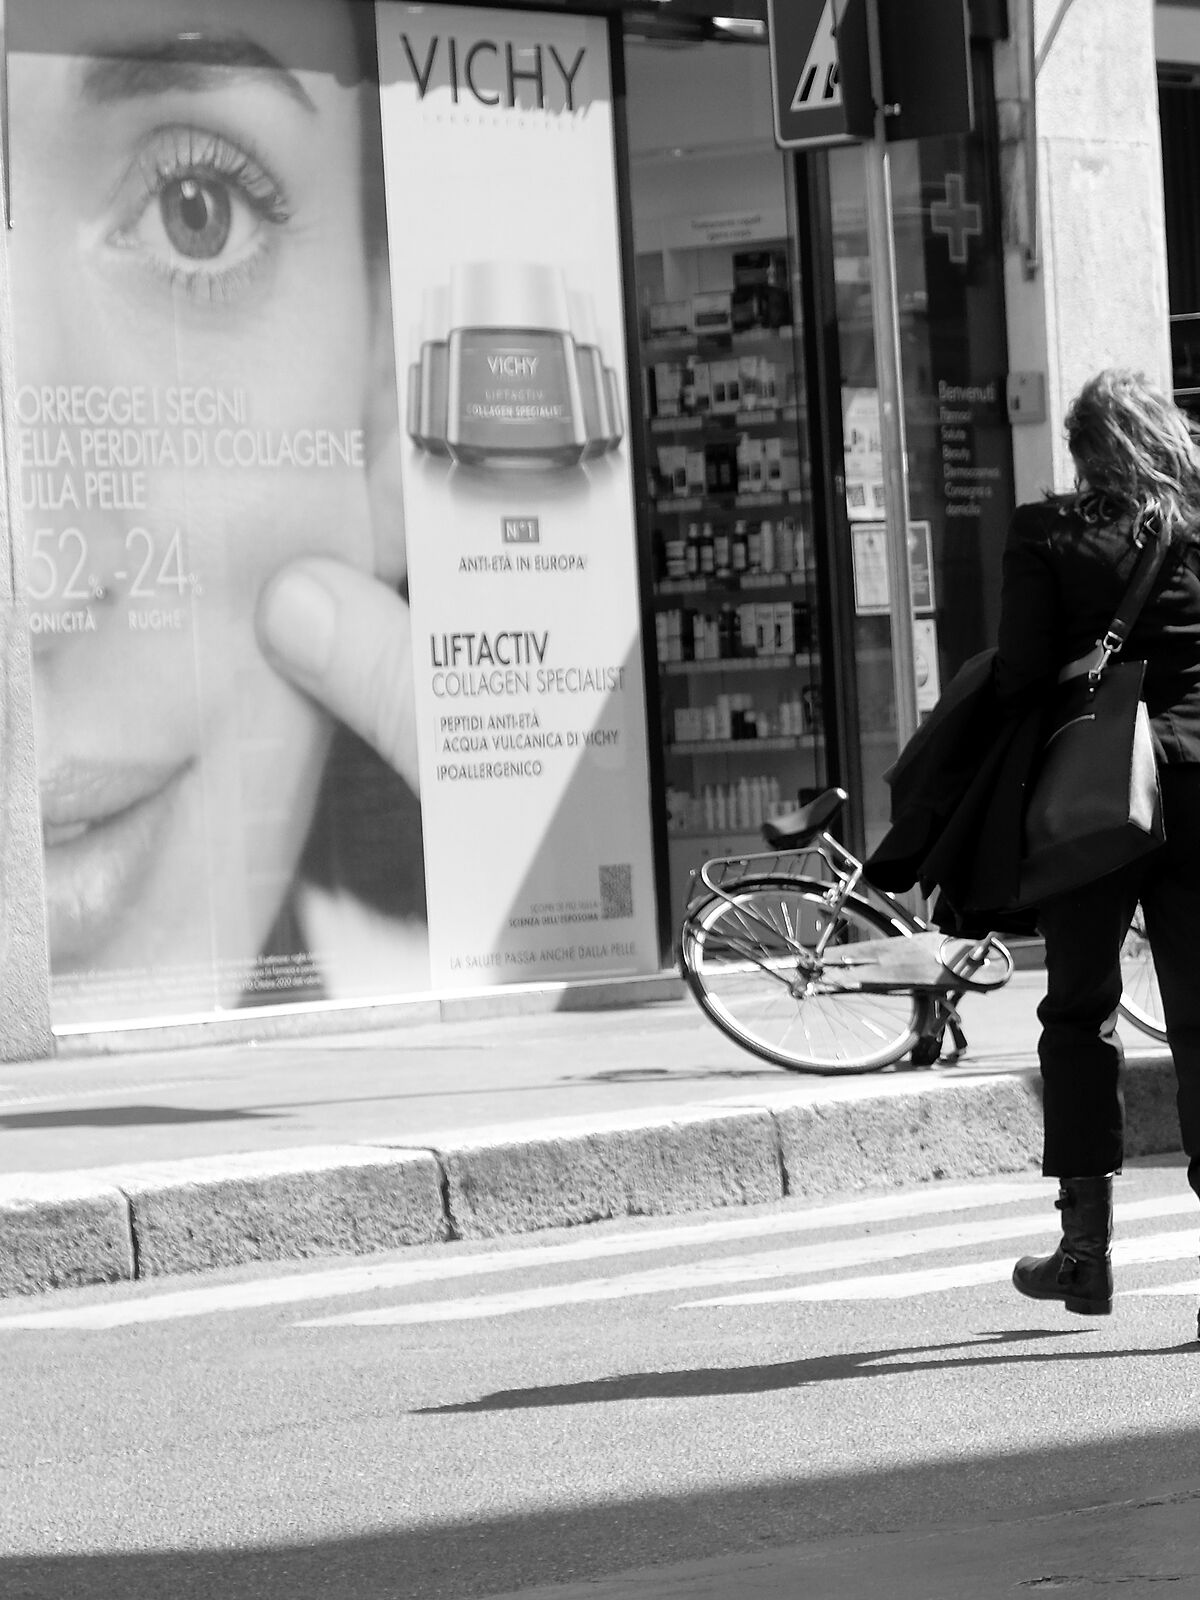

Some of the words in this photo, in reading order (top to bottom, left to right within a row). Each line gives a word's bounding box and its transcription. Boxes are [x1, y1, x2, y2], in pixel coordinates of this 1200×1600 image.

[400, 33, 587, 111] VICHY
[487, 355, 538, 377] VICHY
[16, 385, 147, 424] ORREGGE
[152, 387, 160, 424] I
[166, 386, 247, 424] SEGNI
[20, 428, 77, 468] ELLA
[80, 428, 178, 468] PERDITA
[183, 430, 208, 467] DI
[214, 429, 364, 468] COLLAGENE
[22, 471, 80, 511] ULLA
[84, 470, 147, 511] PELLE
[26, 527, 104, 599] 52%
[516, 555, 530, 571] IN
[534, 554, 585, 572] EUROPA
[30, 607, 97, 634] ONICITÀ
[128, 608, 185, 633] RUGHE
[431, 631, 549, 667] LIFTACTIV
[432, 669, 530, 697] COLLAGEN
[536, 666, 625, 694] SPECIALIST
[440, 715, 483, 732] PEPTIDI
[442, 736, 488, 752] ACQUA
[492, 732, 563, 750] VULCANICA
[566, 731, 578, 746] DI
[582, 729, 619, 747] VICHY
[436, 760, 542, 781] IPOALLERGENICO
[450, 957, 462, 970] LA
[466, 954, 502, 969] SALUTE
[505, 952, 536, 966] PASSA
[540, 947, 575, 962] ANCHE
[578, 944, 607, 959] DALLA
[611, 941, 636, 956] PELLE
